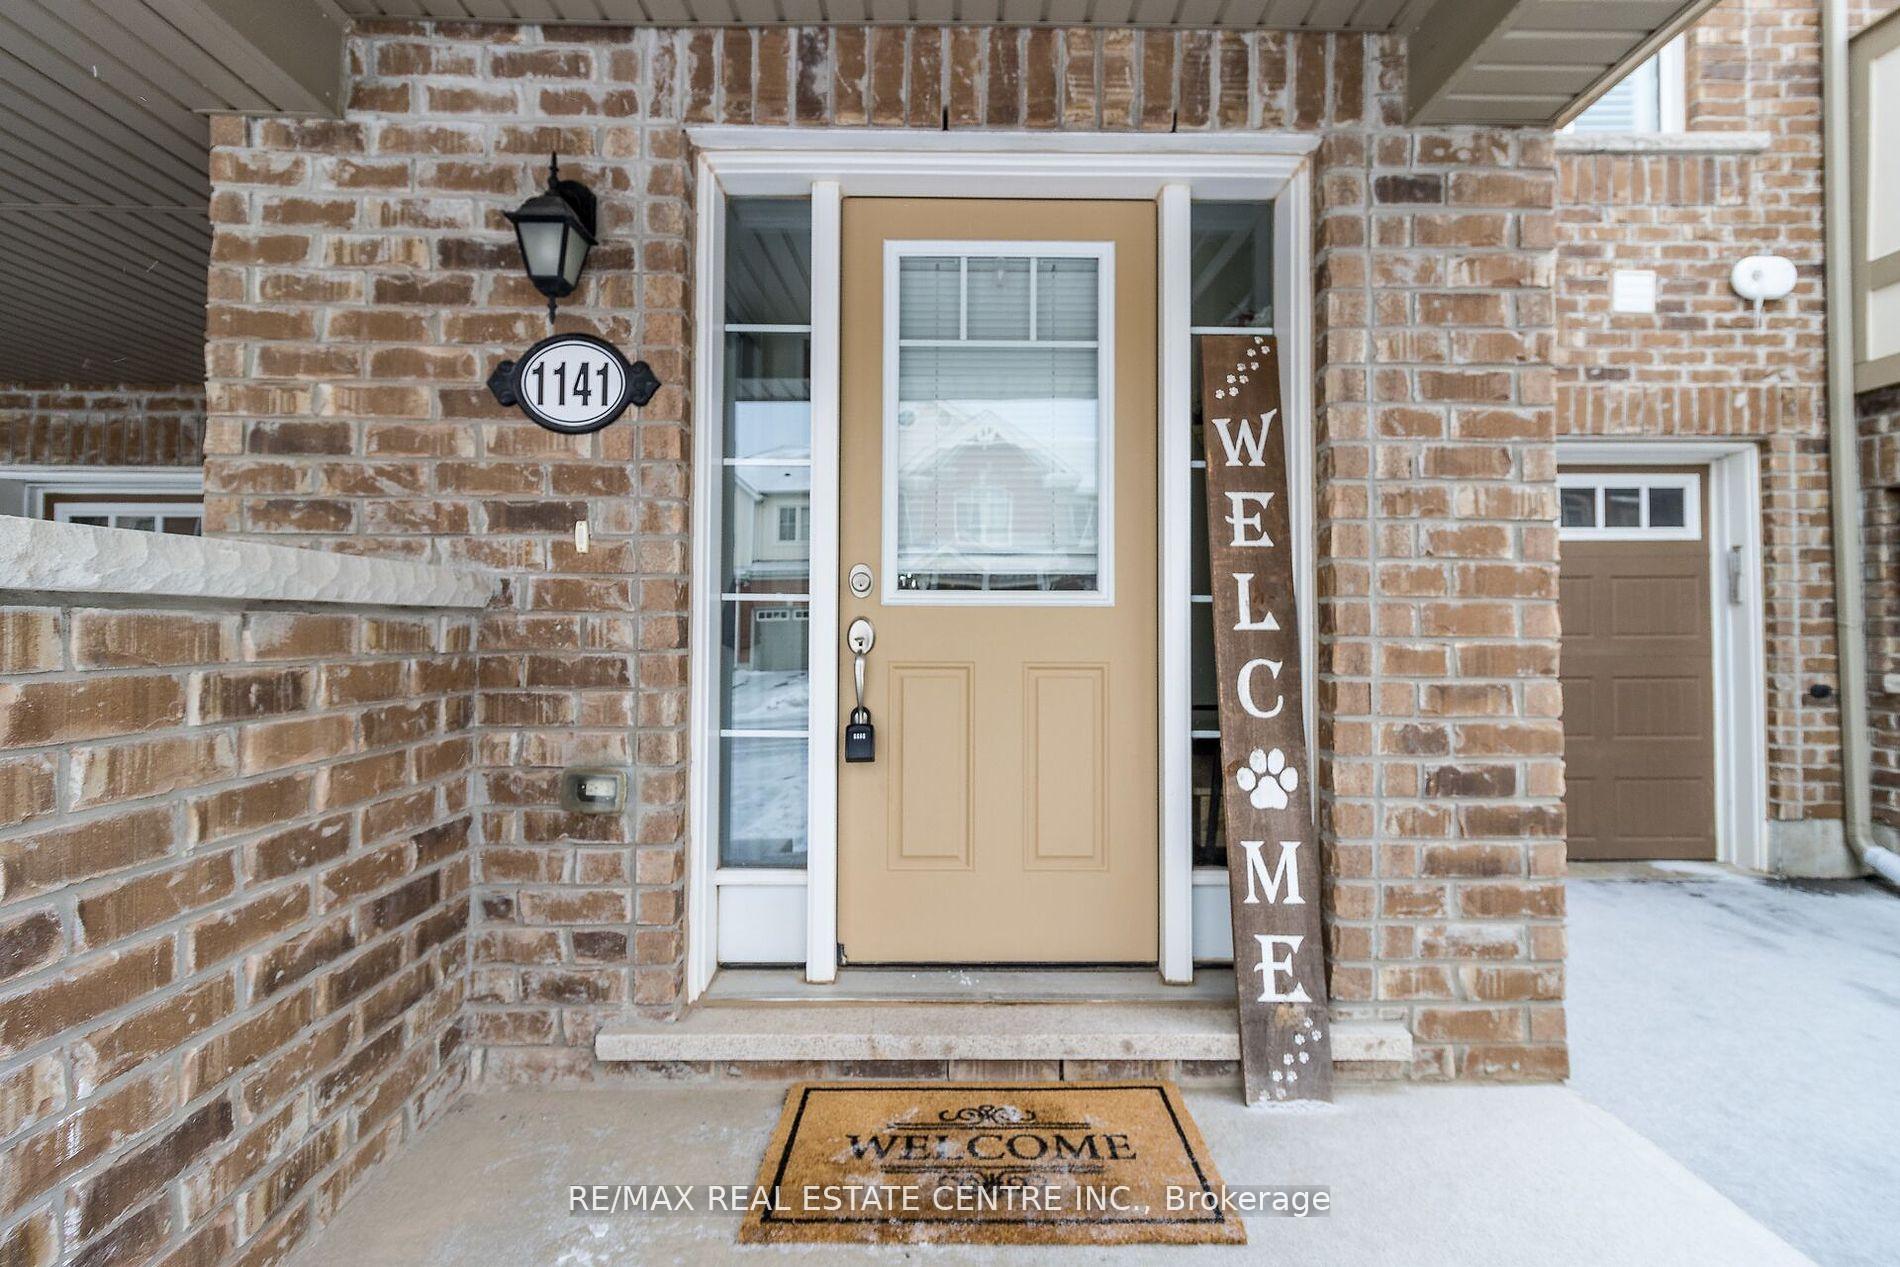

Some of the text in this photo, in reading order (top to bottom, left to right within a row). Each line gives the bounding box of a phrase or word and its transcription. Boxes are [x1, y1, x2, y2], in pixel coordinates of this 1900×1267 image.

[531, 361, 609, 406] 1141
[1211, 408, 1313, 1002] WELCME
[846, 1132, 1138, 1161] WELCOME
